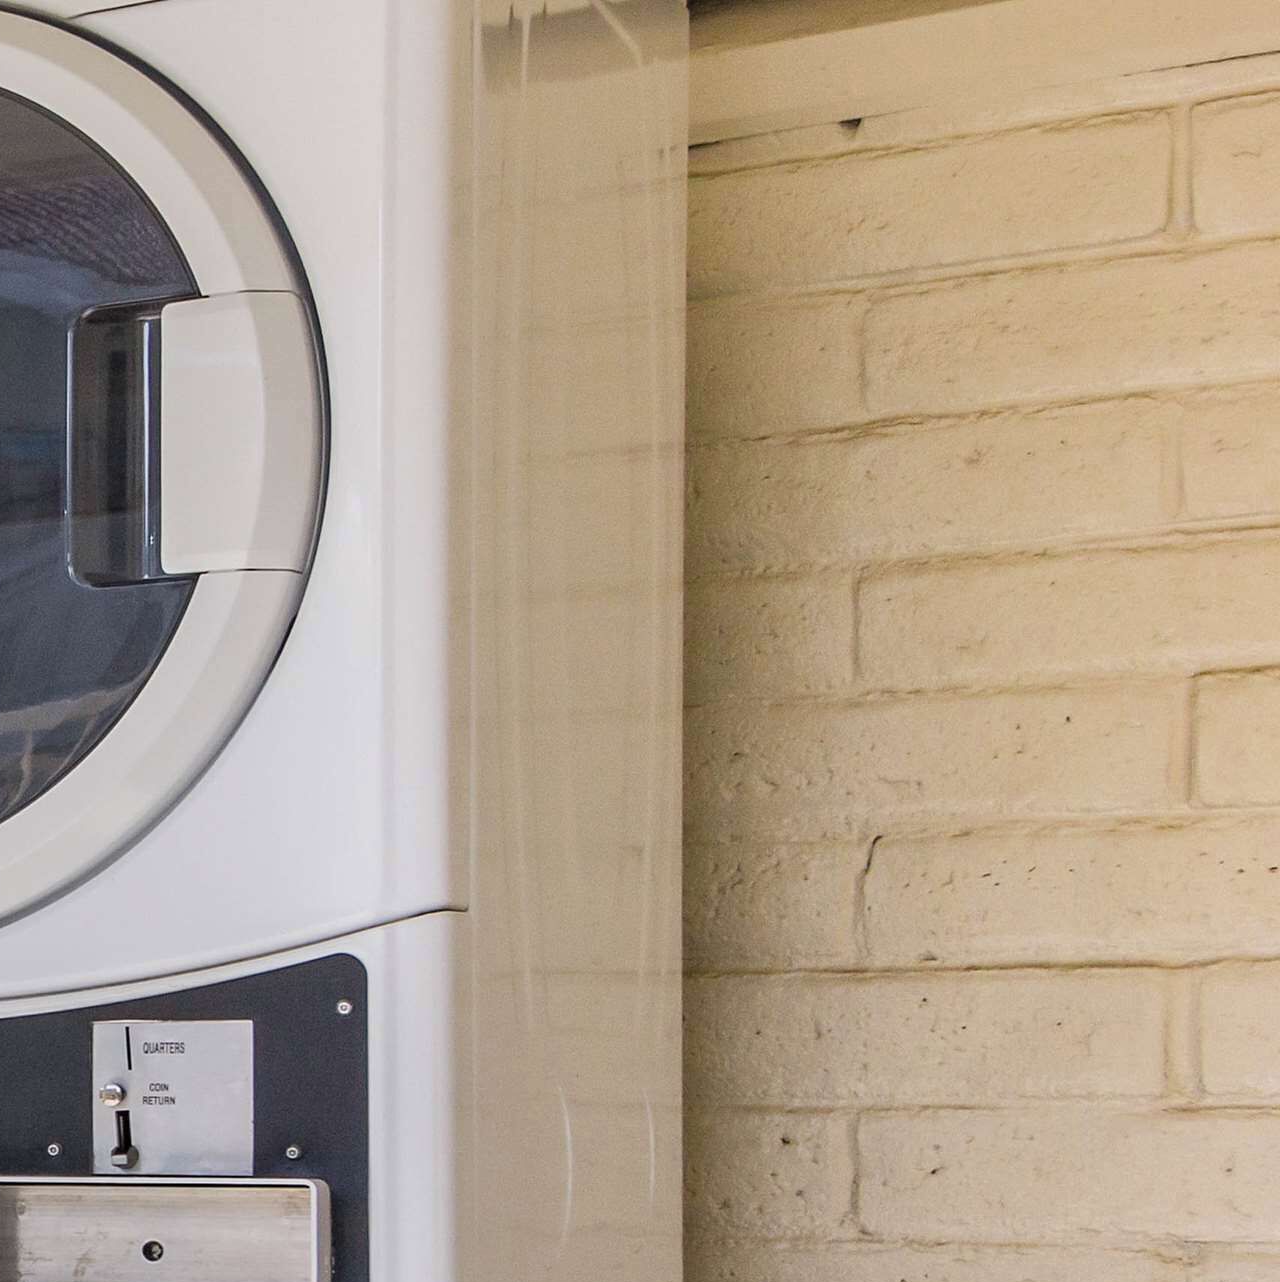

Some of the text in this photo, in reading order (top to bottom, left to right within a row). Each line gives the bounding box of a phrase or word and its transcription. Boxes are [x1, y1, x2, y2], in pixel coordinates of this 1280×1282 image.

[143, 1042, 185, 1054] QUARTERS
[149, 1083, 169, 1092] COIN
[142, 1096, 176, 1105] RETURN
